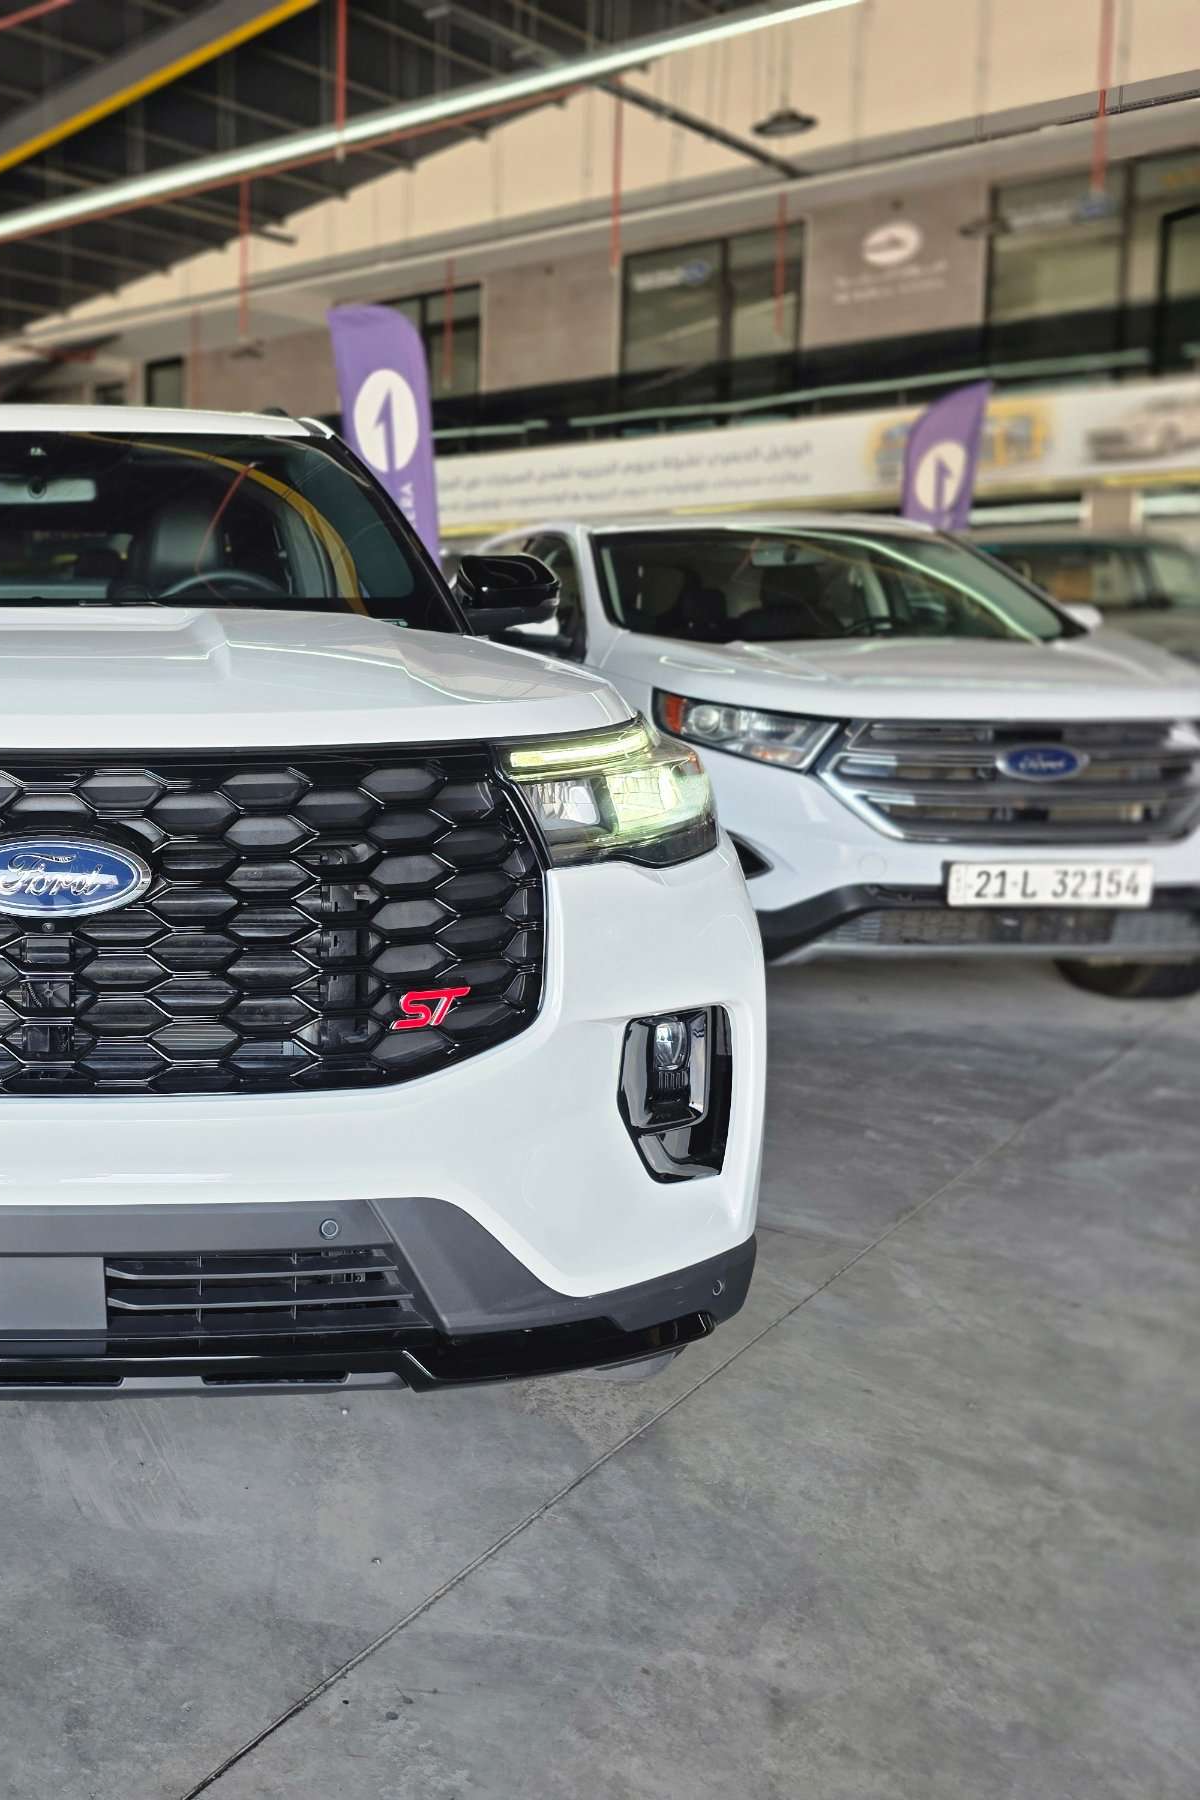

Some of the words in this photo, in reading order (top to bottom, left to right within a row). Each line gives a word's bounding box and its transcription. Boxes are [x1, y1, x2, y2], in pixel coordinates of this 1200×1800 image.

[974, 869, 1008, 899] 21
[1050, 869, 1140, 899] 32154
[388, 986, 471, 1030] ST
